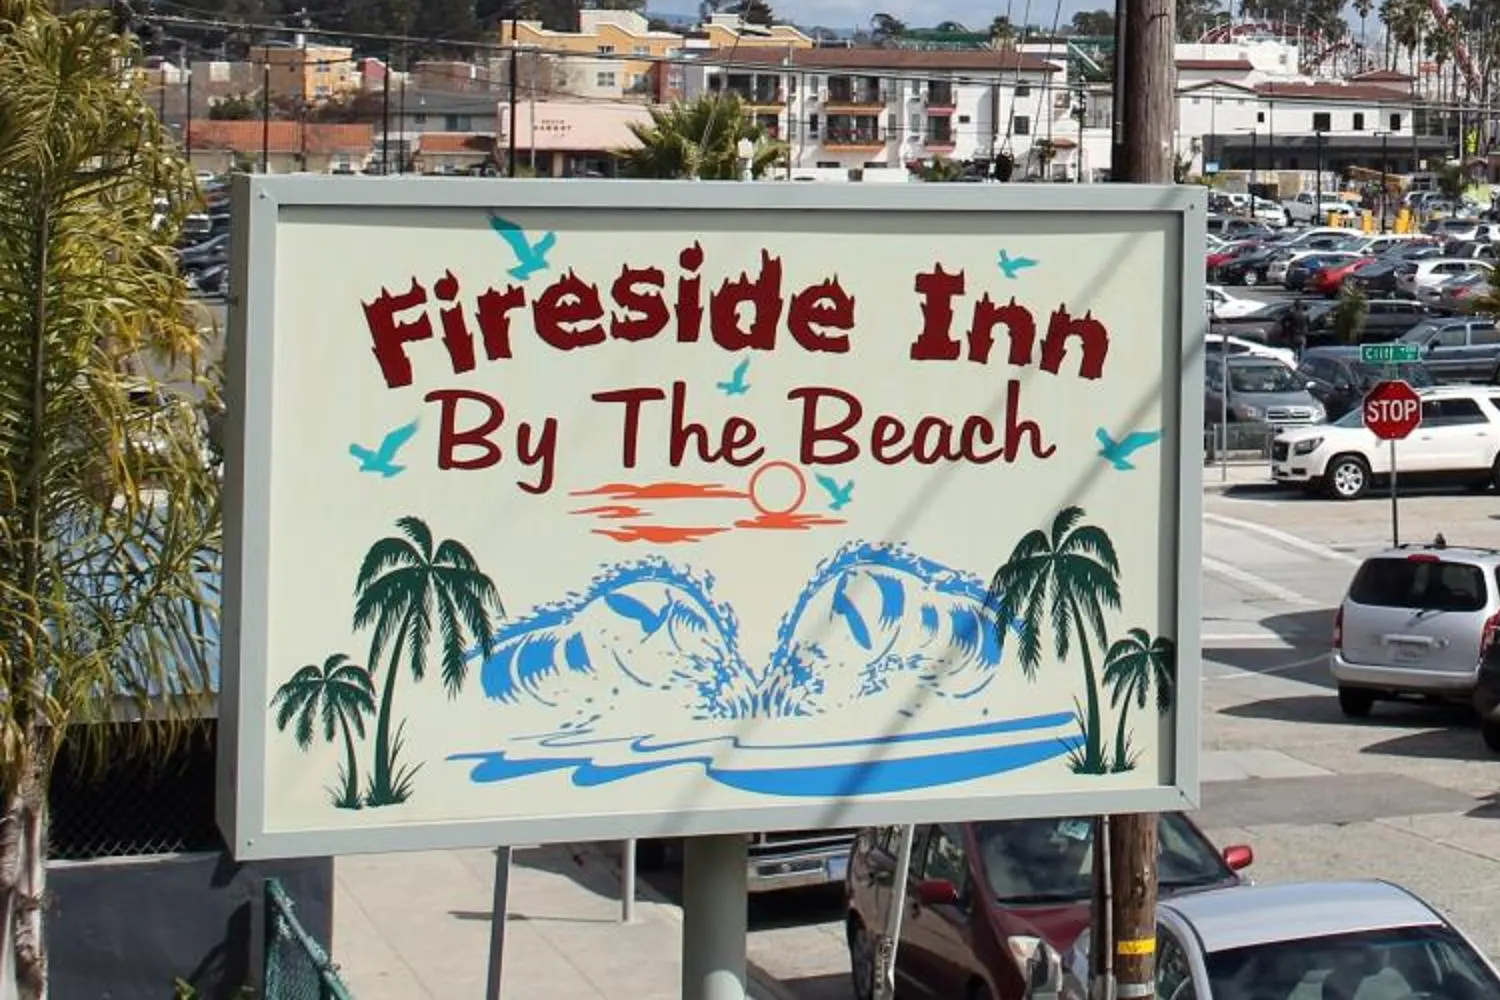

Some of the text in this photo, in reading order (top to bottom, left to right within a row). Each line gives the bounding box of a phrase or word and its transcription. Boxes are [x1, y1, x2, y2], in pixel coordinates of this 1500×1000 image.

[361, 239, 1109, 389] Fireside Inn
[426, 379, 1057, 495] By The Beach
[1366, 399, 1418, 423] STOP
